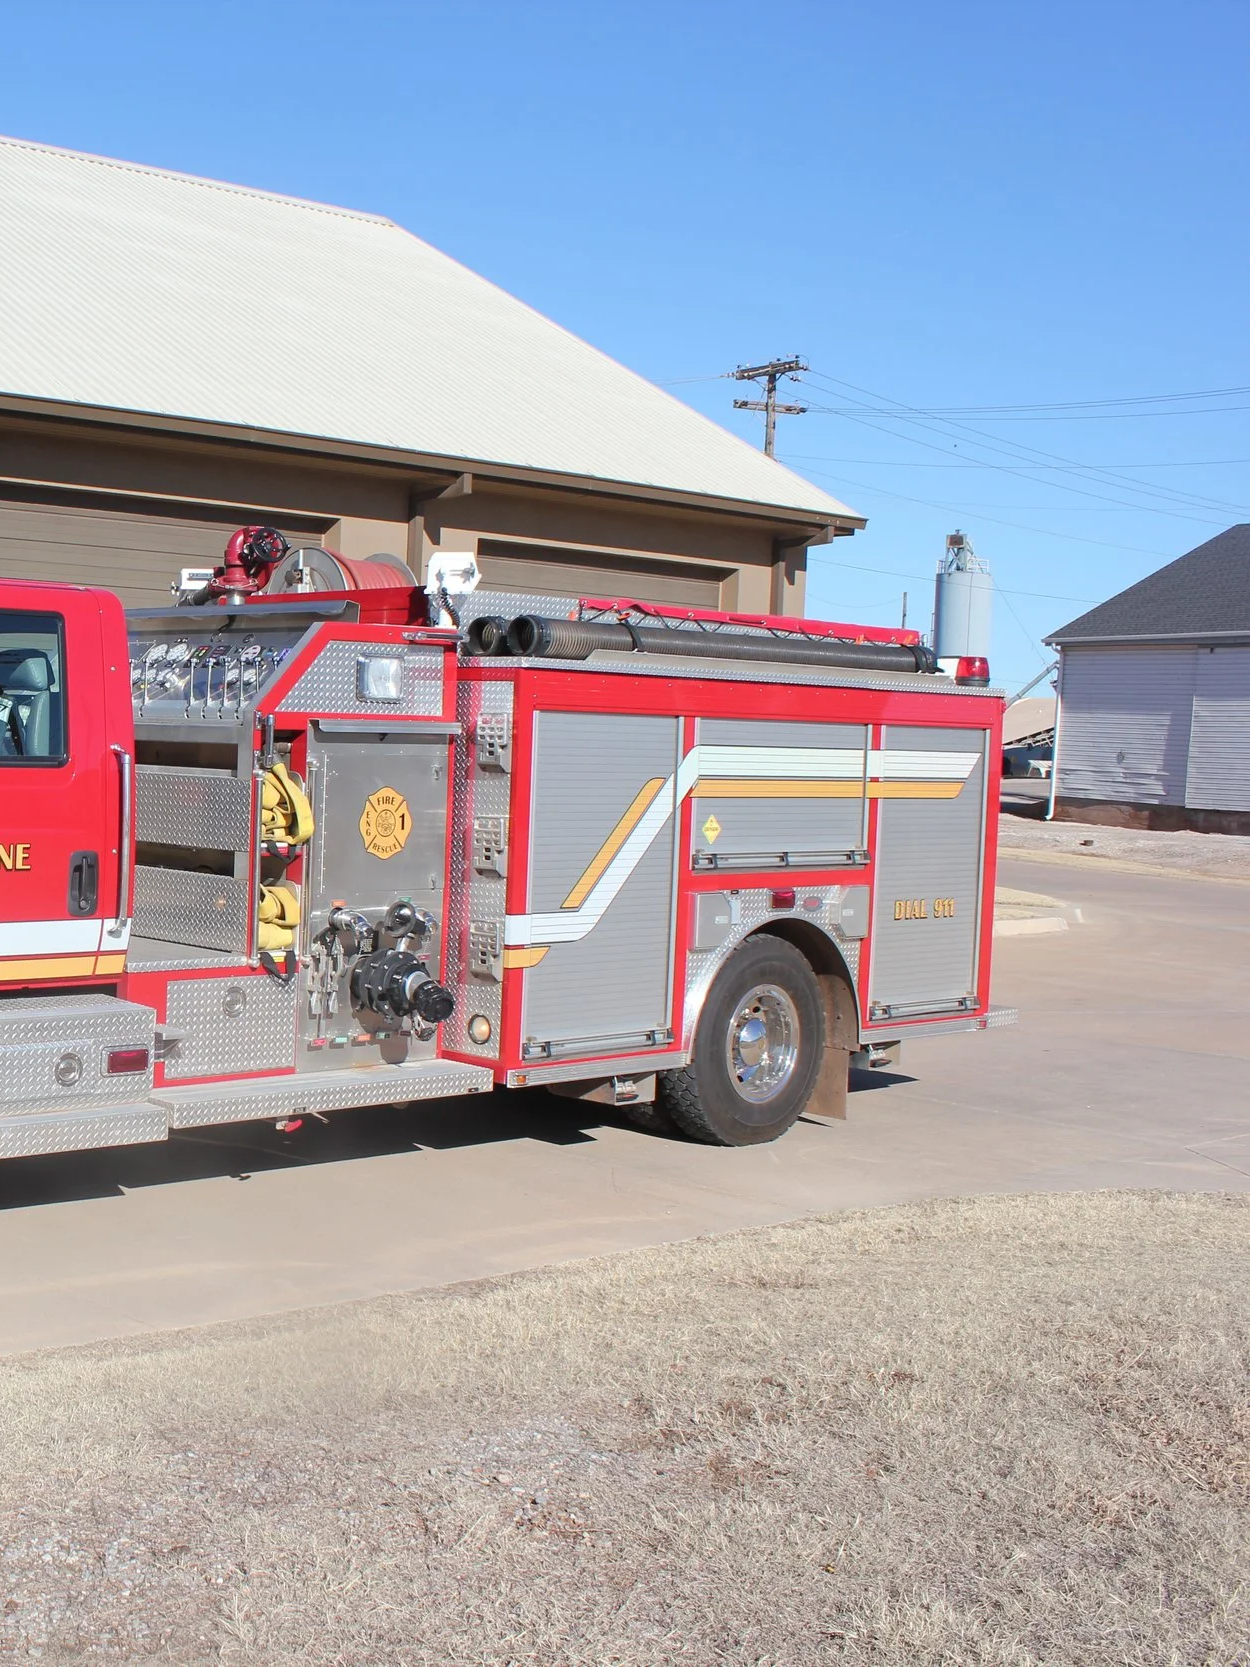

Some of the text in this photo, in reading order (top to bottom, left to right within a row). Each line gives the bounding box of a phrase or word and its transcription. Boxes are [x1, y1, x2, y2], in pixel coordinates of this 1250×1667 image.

[376, 795, 396, 806] FIRE
[399, 812, 405, 831] 1
[371, 842, 398, 854] RESCUE
[894, 898, 955, 920] DIAL 911
